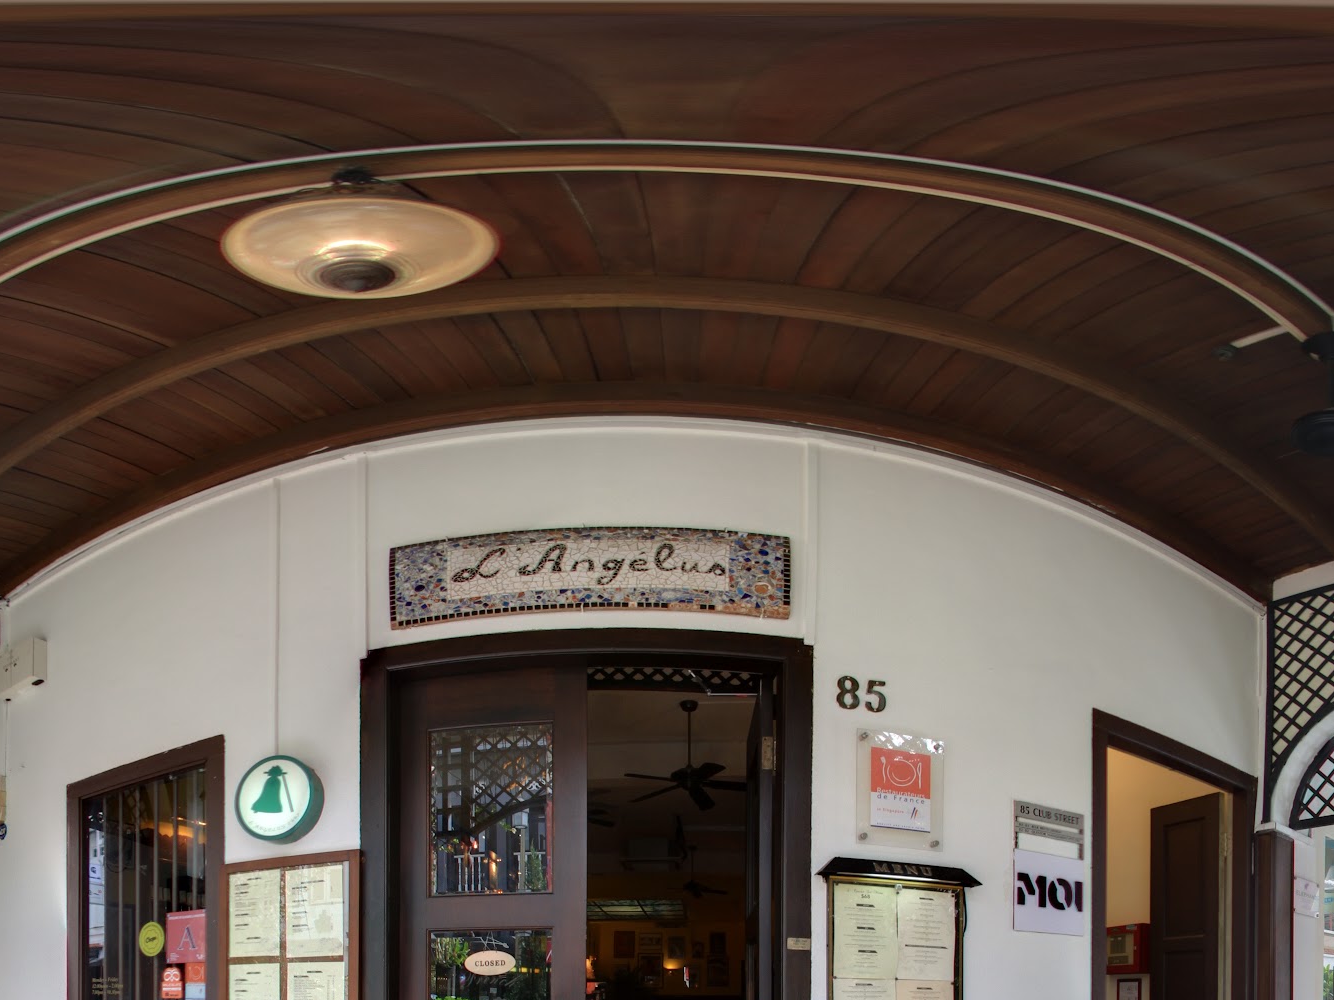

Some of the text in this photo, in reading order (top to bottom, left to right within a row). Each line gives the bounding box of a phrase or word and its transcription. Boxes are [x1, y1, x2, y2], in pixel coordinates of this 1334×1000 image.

[452, 543, 726, 585] L'Angélus
[836, 676, 886, 712] 85
[876, 787, 925, 799] Restaurateurs
[893, 795, 925, 805] France
[1020, 805, 1079, 825] 85 CLUB STREET
[873, 862, 932, 876] MENU
[1017, 872, 1083, 912] MOI
